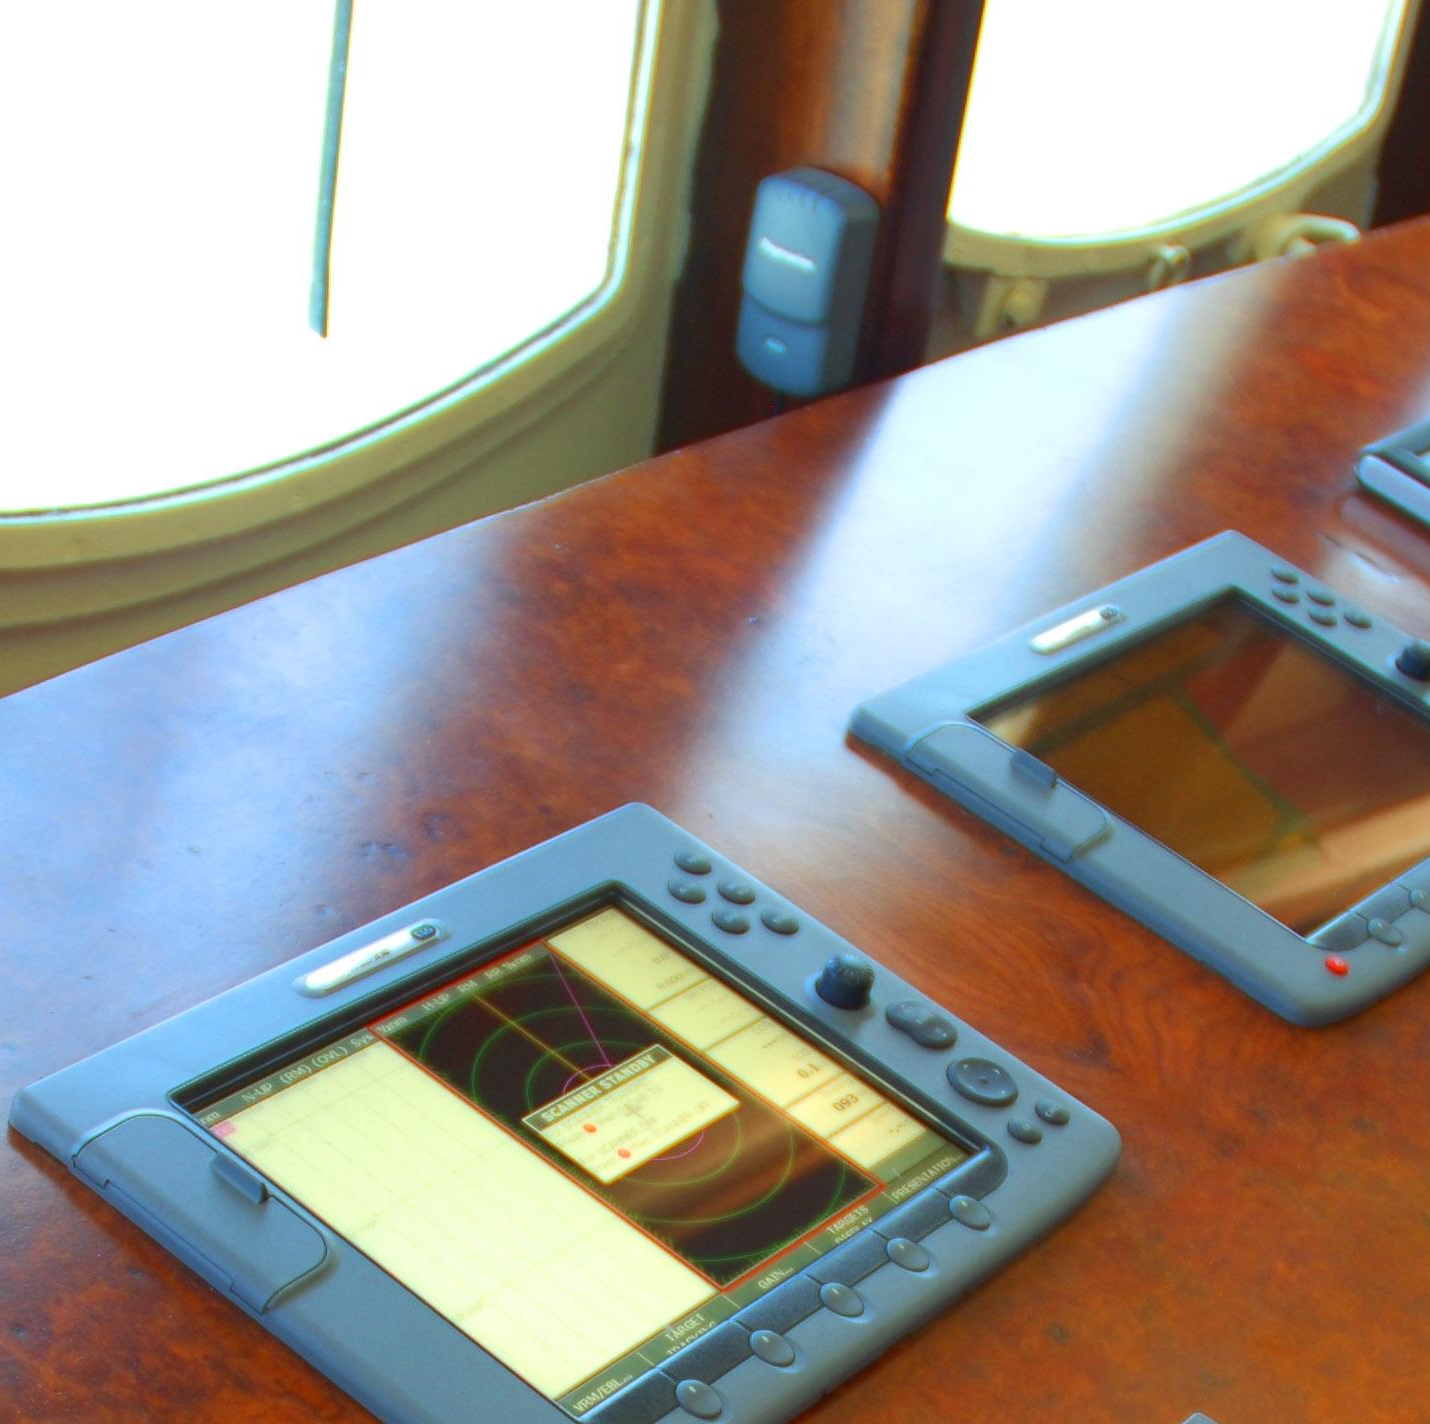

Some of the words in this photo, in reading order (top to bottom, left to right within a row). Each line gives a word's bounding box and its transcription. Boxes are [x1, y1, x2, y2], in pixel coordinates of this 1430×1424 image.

[240, 1082, 273, 1104] N-UP
[312, 1045, 350, 1069] (OVL)
[540, 1082, 600, 1123] SCANNER
[598, 1053, 656, 1090] STANDBY
[832, 1093, 860, 1113] 093
[827, 1204, 870, 1234] TARGETS
[665, 1312, 706, 1343] TARGET
